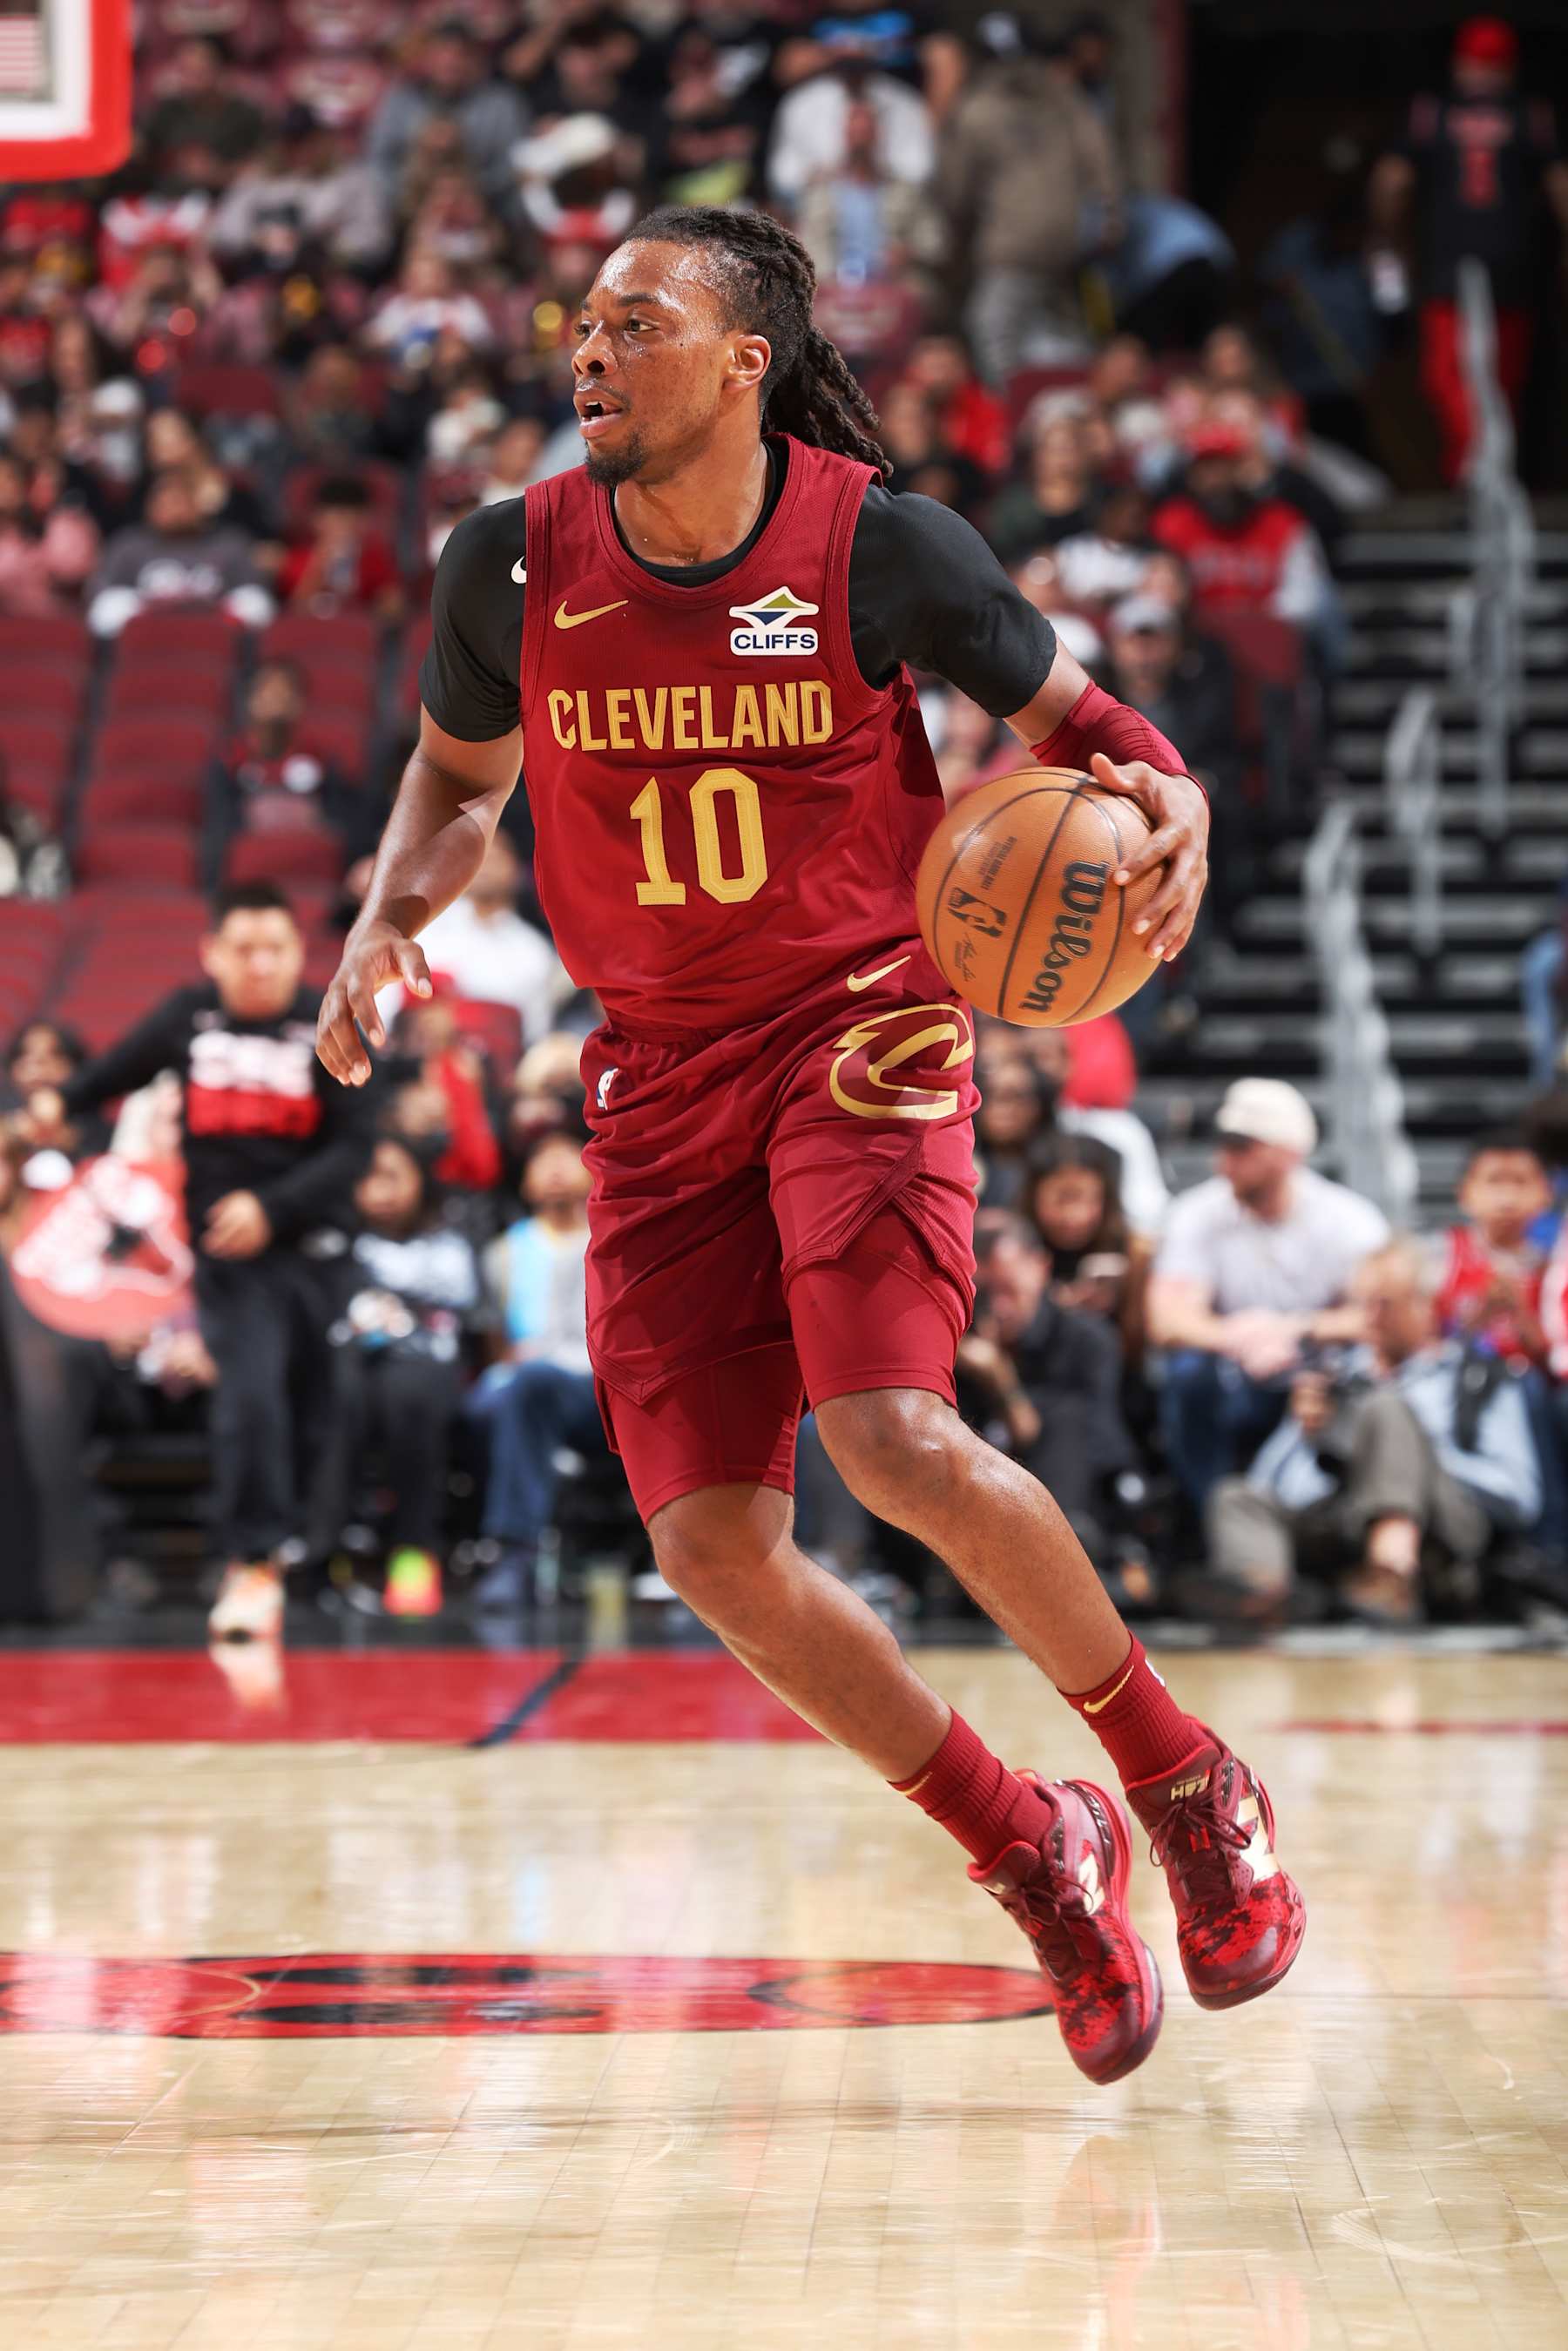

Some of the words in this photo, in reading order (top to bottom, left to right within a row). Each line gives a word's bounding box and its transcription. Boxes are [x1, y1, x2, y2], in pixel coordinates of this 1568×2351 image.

[733, 633, 816, 650] CLIFFS
[547, 680, 834, 751] CLEVELAND
[629, 767, 768, 905] 10
[1017, 859, 1111, 1012] Wilson
